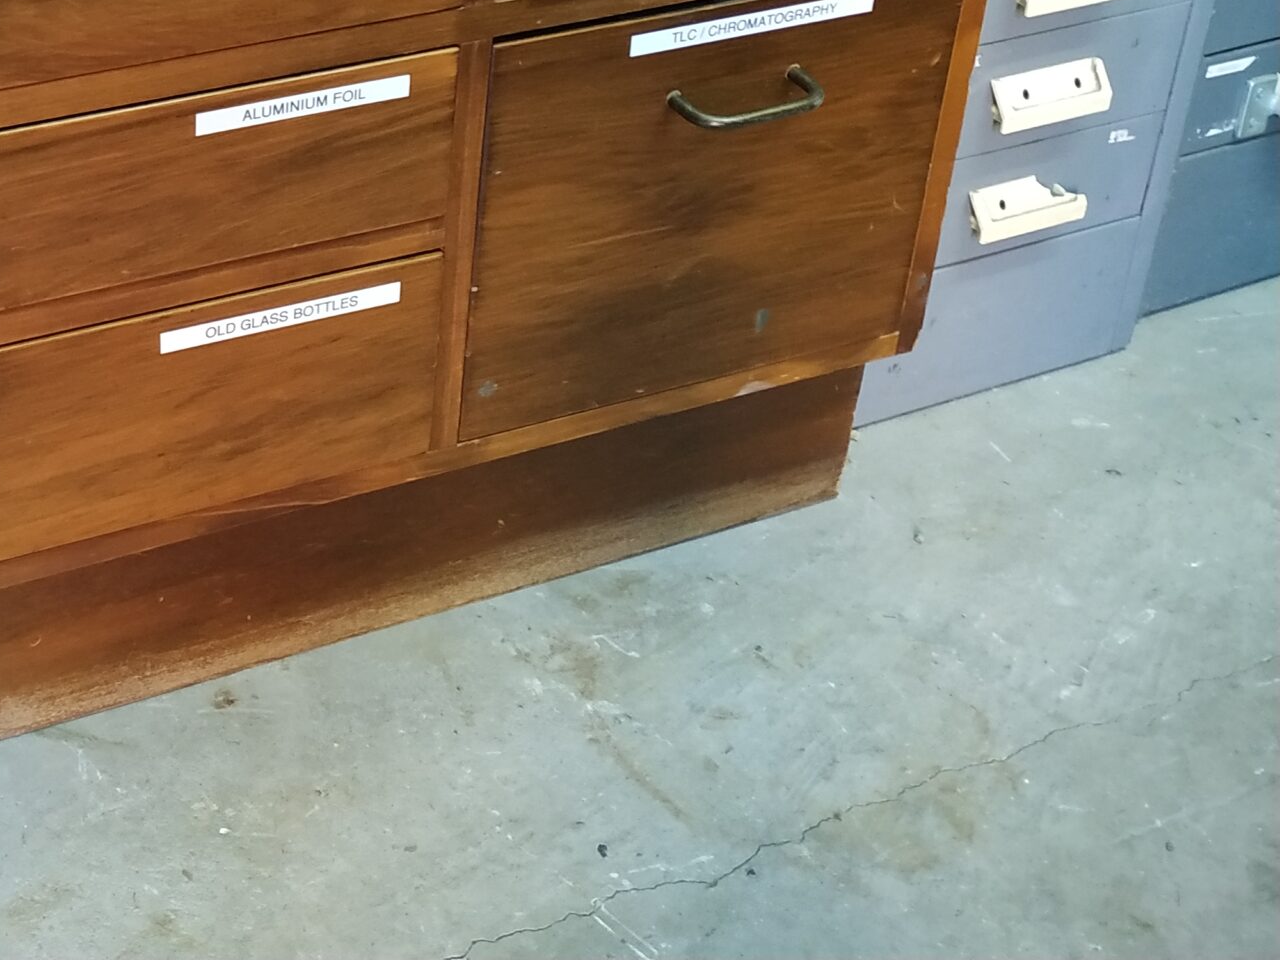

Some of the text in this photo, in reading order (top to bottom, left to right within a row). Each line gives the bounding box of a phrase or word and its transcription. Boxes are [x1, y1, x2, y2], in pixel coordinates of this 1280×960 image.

[672, 28, 697, 44] TLC
[708, 3, 838, 37] CHROMATOGRAPHY
[242, 88, 366, 122] ALUMINIUM FOIL
[205, 295, 359, 339] OLD GLASS BOTTLES
